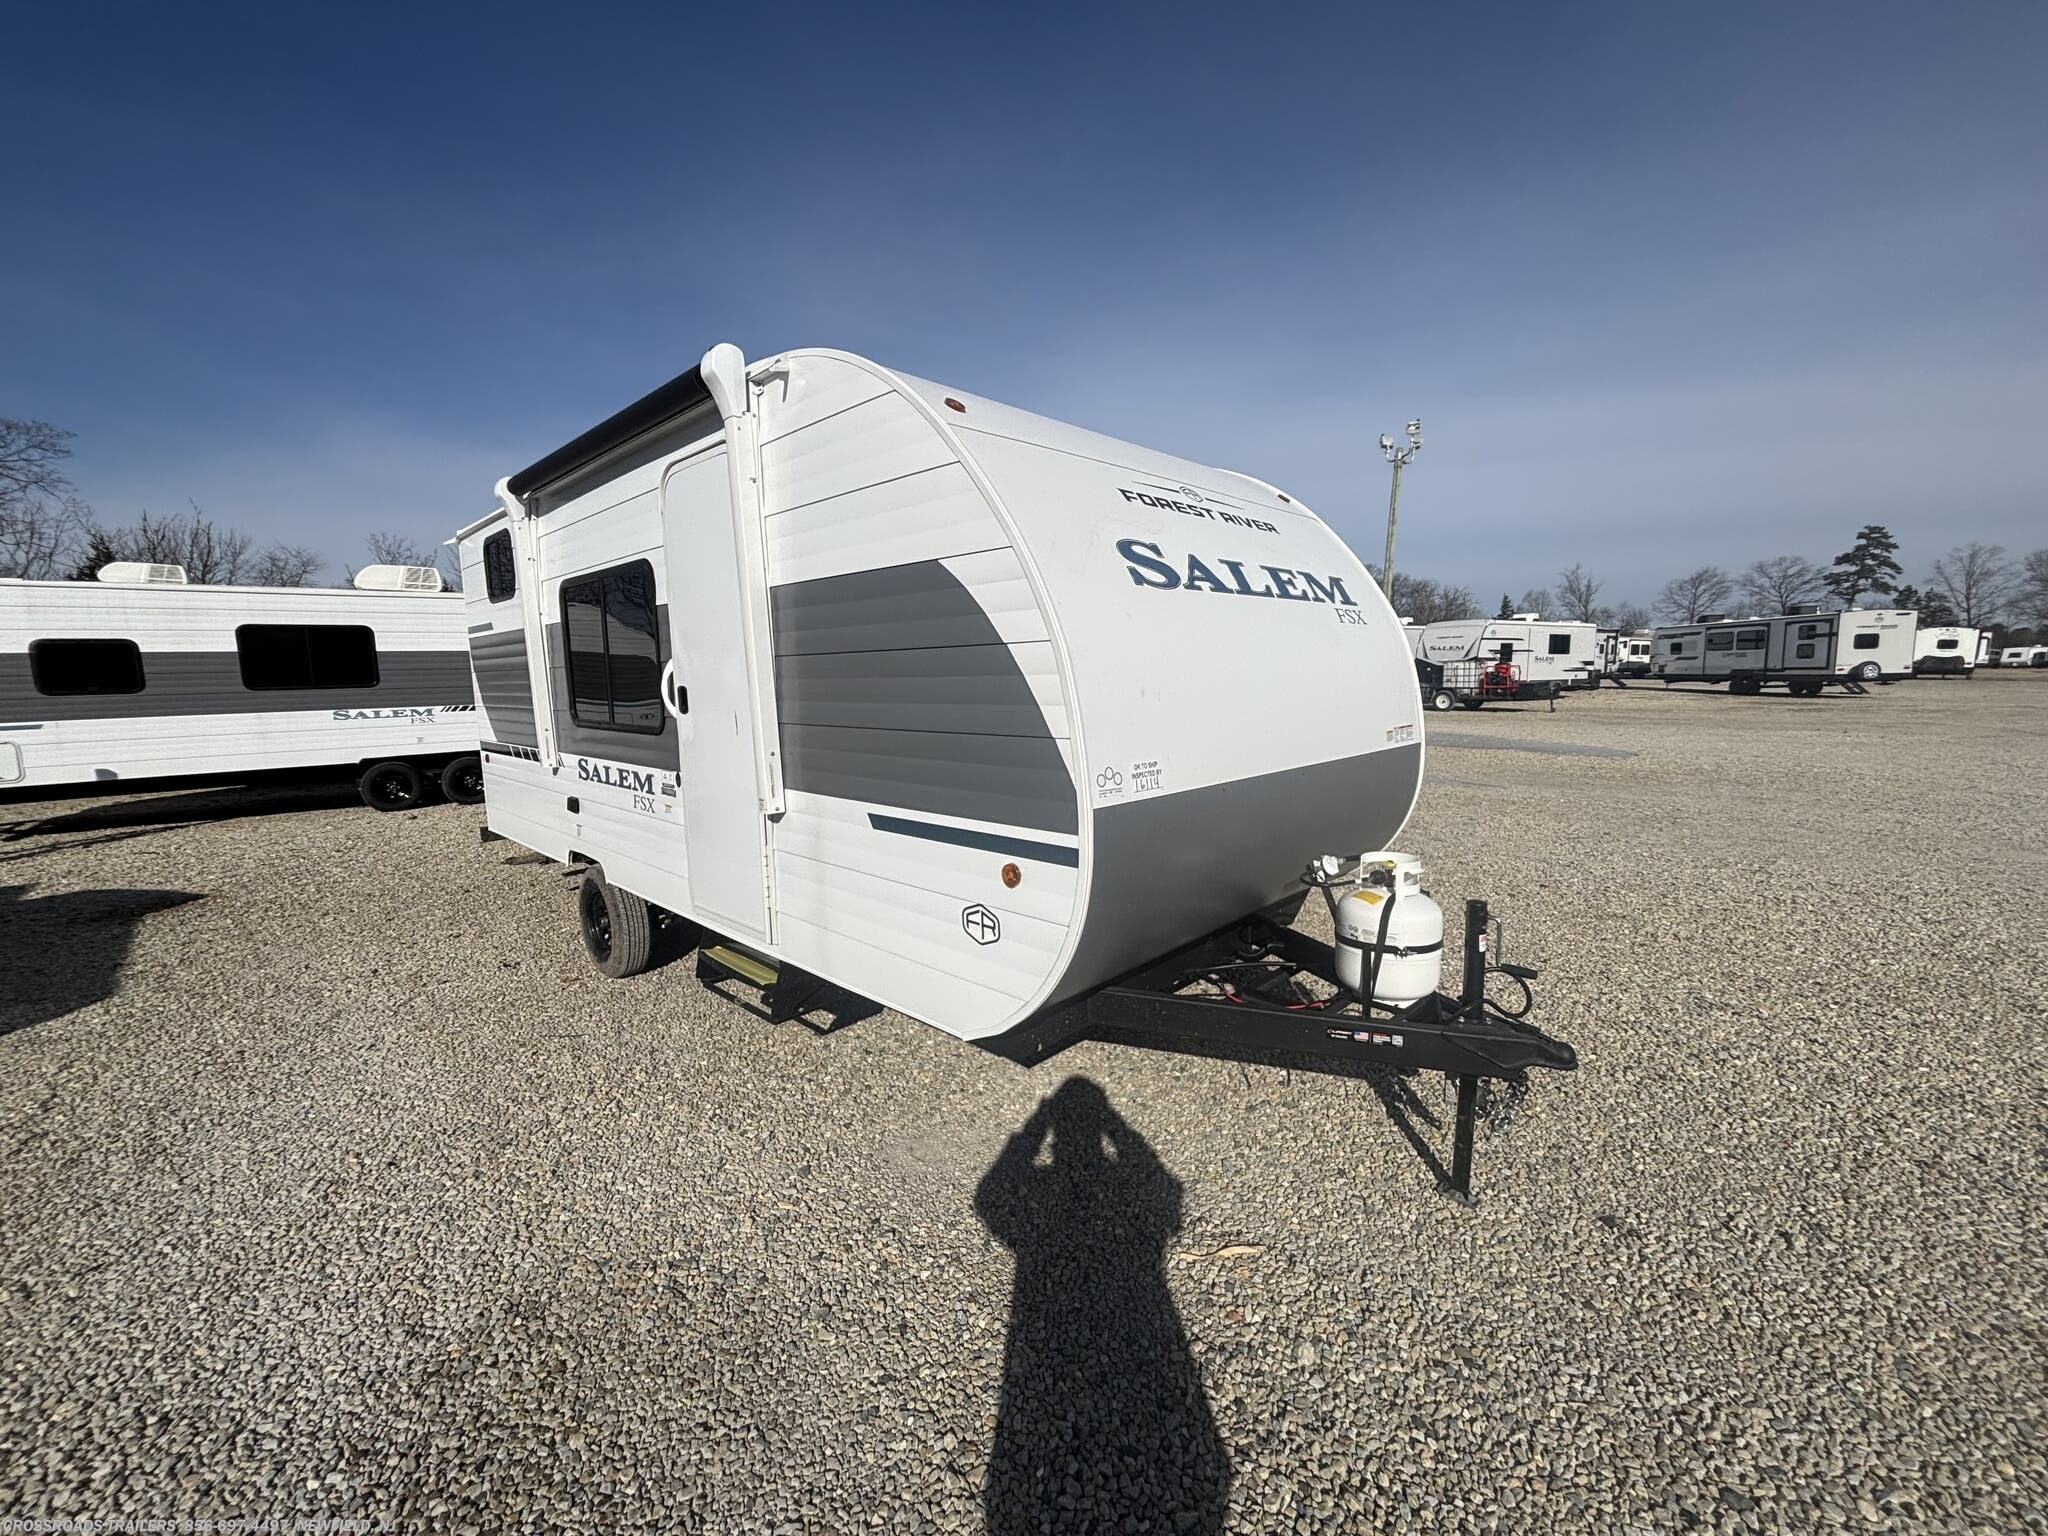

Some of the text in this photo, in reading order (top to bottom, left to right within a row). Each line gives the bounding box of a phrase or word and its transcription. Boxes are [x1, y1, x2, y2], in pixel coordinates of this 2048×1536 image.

[1117, 488, 1281, 535] FOREST RIVER
[1115, 537, 1359, 607] SALEM
[1335, 607, 1369, 626] FSX
[332, 708, 436, 721] SALEM
[411, 716, 436, 724] FSX
[1131, 769, 1156, 780] INSPECTED
[1133, 763, 1141, 771] OK
[1141, 762, 1148, 770] TO
[577, 757, 655, 796] SALEM
[633, 794, 656, 814] FSX
